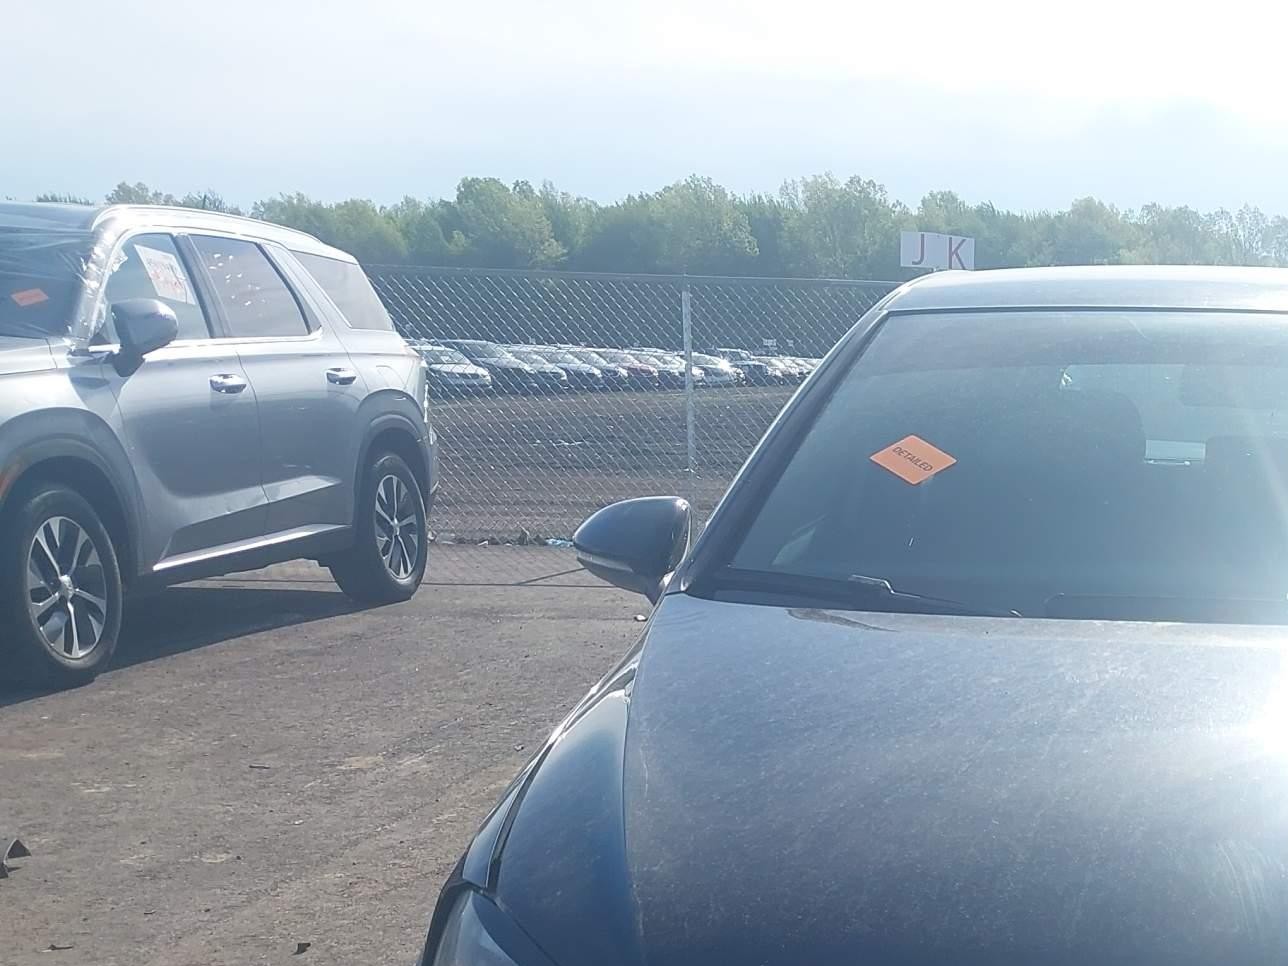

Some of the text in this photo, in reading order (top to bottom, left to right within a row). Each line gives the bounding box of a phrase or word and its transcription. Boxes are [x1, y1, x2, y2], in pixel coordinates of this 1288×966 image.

[912, 233, 925, 266] J
[948, 237, 967, 270] K
[892, 446, 934, 472] DETAILED
